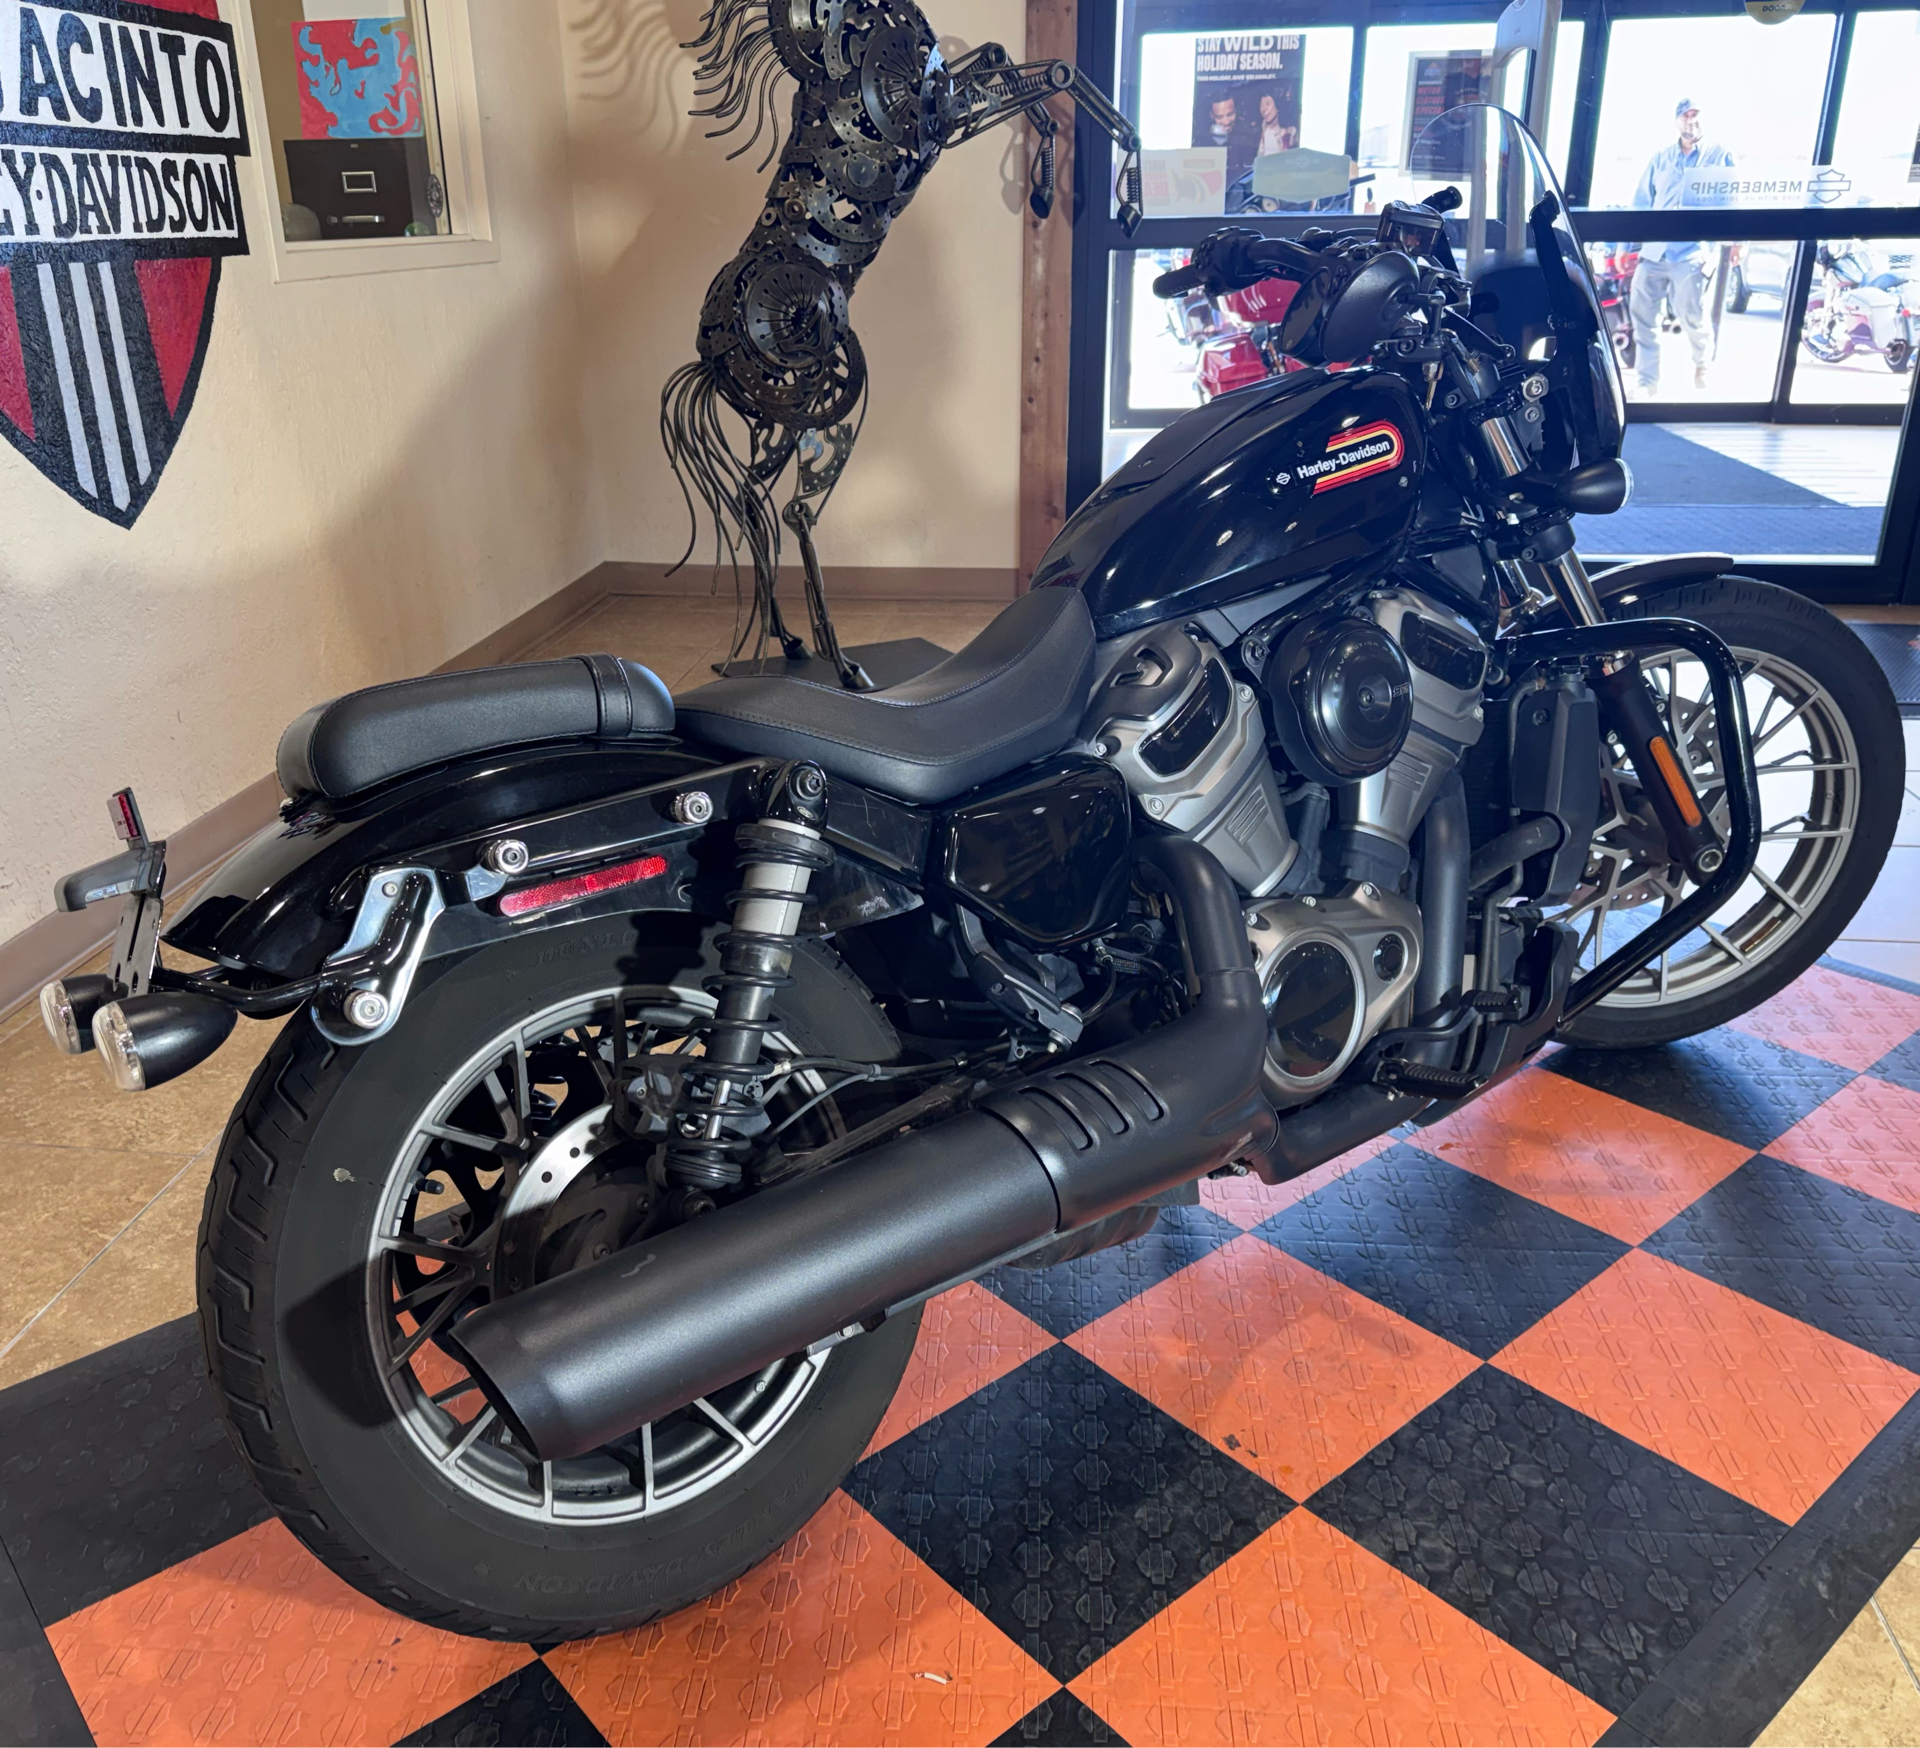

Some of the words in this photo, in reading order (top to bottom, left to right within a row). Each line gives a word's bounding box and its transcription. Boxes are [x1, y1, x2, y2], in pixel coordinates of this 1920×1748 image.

[1197, 37, 1221, 53] STAY
[1223, 35, 1275, 52] WILD
[1276, 34, 1300, 50] THIS
[1197, 53, 1239, 71] HOLIDAY
[1240, 52, 1283, 70] SEASON.
[0, 7, 230, 132] ACINTO
[1296, 440, 1391, 479] Harley-Davidson
[1334, 640, 1379, 679] REVOUTION
[535, 929, 639, 967] DUNLO
